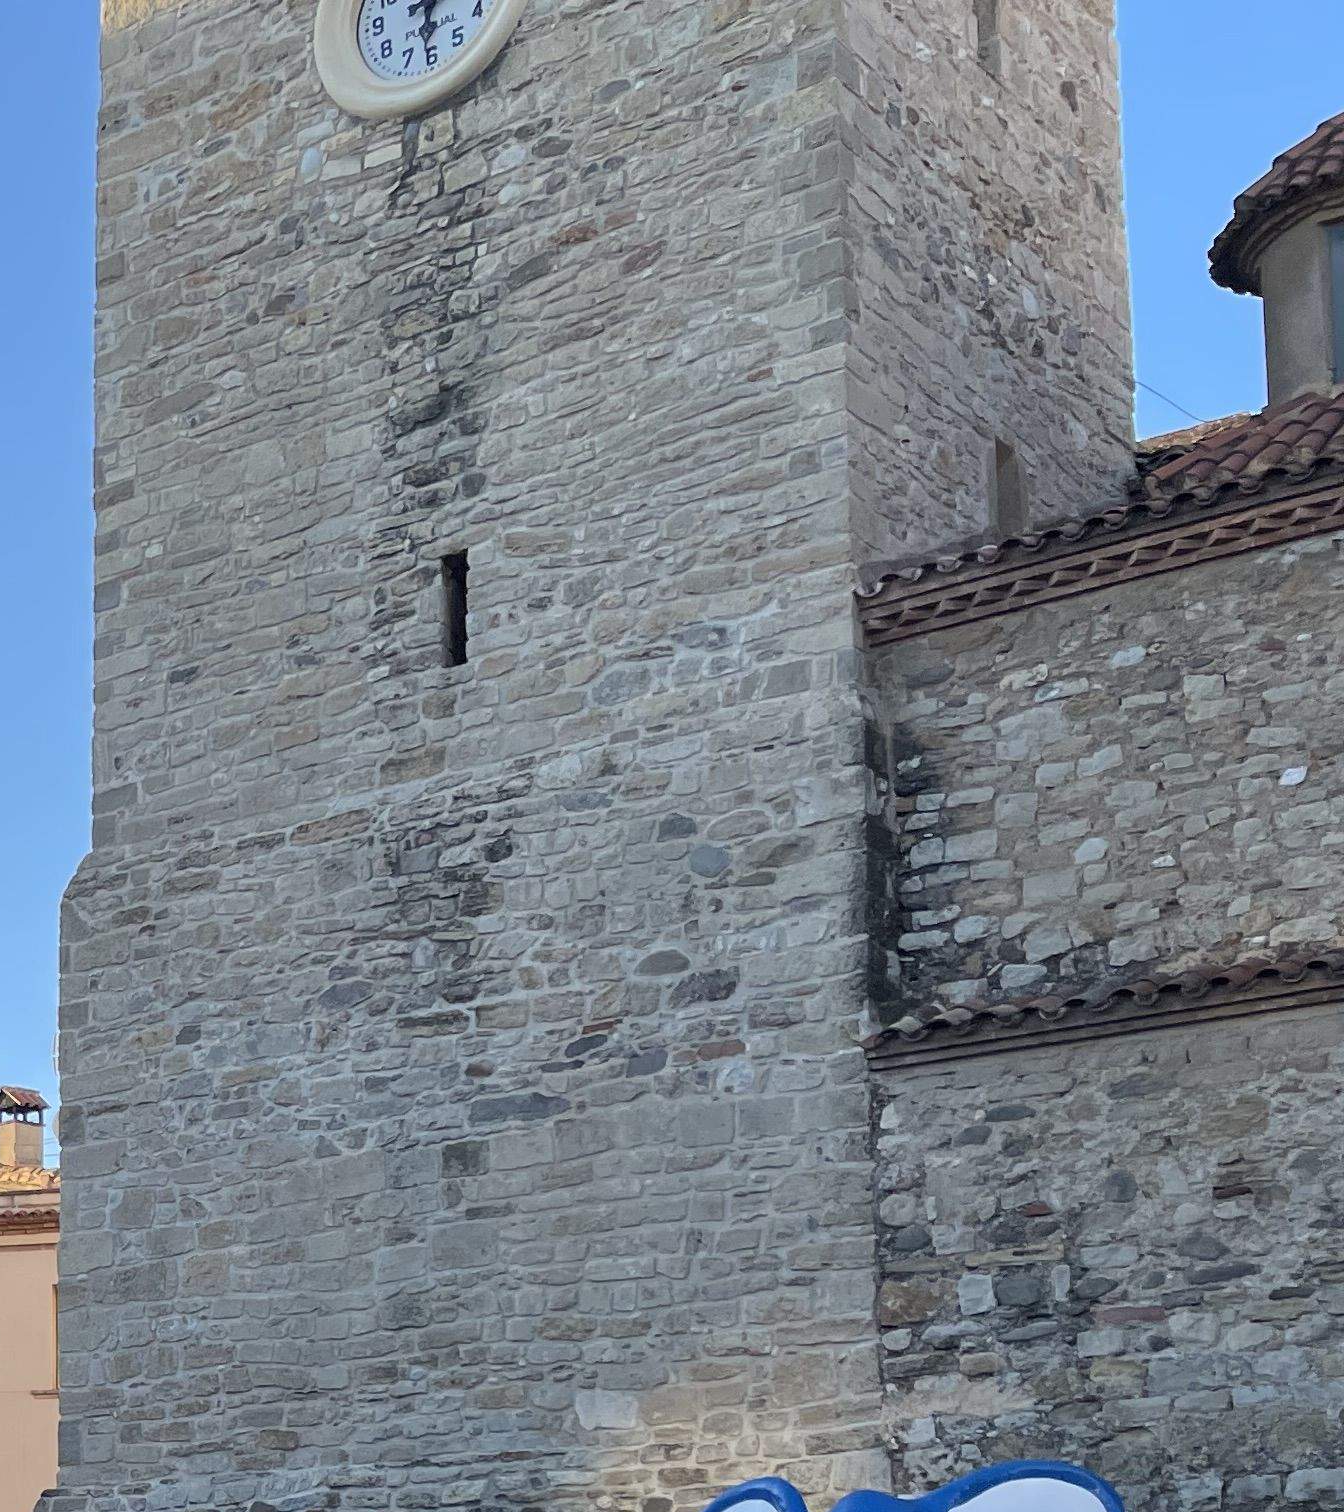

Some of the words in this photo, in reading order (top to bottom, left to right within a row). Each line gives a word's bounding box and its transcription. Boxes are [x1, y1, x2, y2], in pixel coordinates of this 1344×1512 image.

[372, 16, 384, 37] 9
[451, 25, 464, 48] 5
[380, 39, 393, 59] 8
[402, 47, 415, 70] 7
[426, 45, 438, 66] 6
